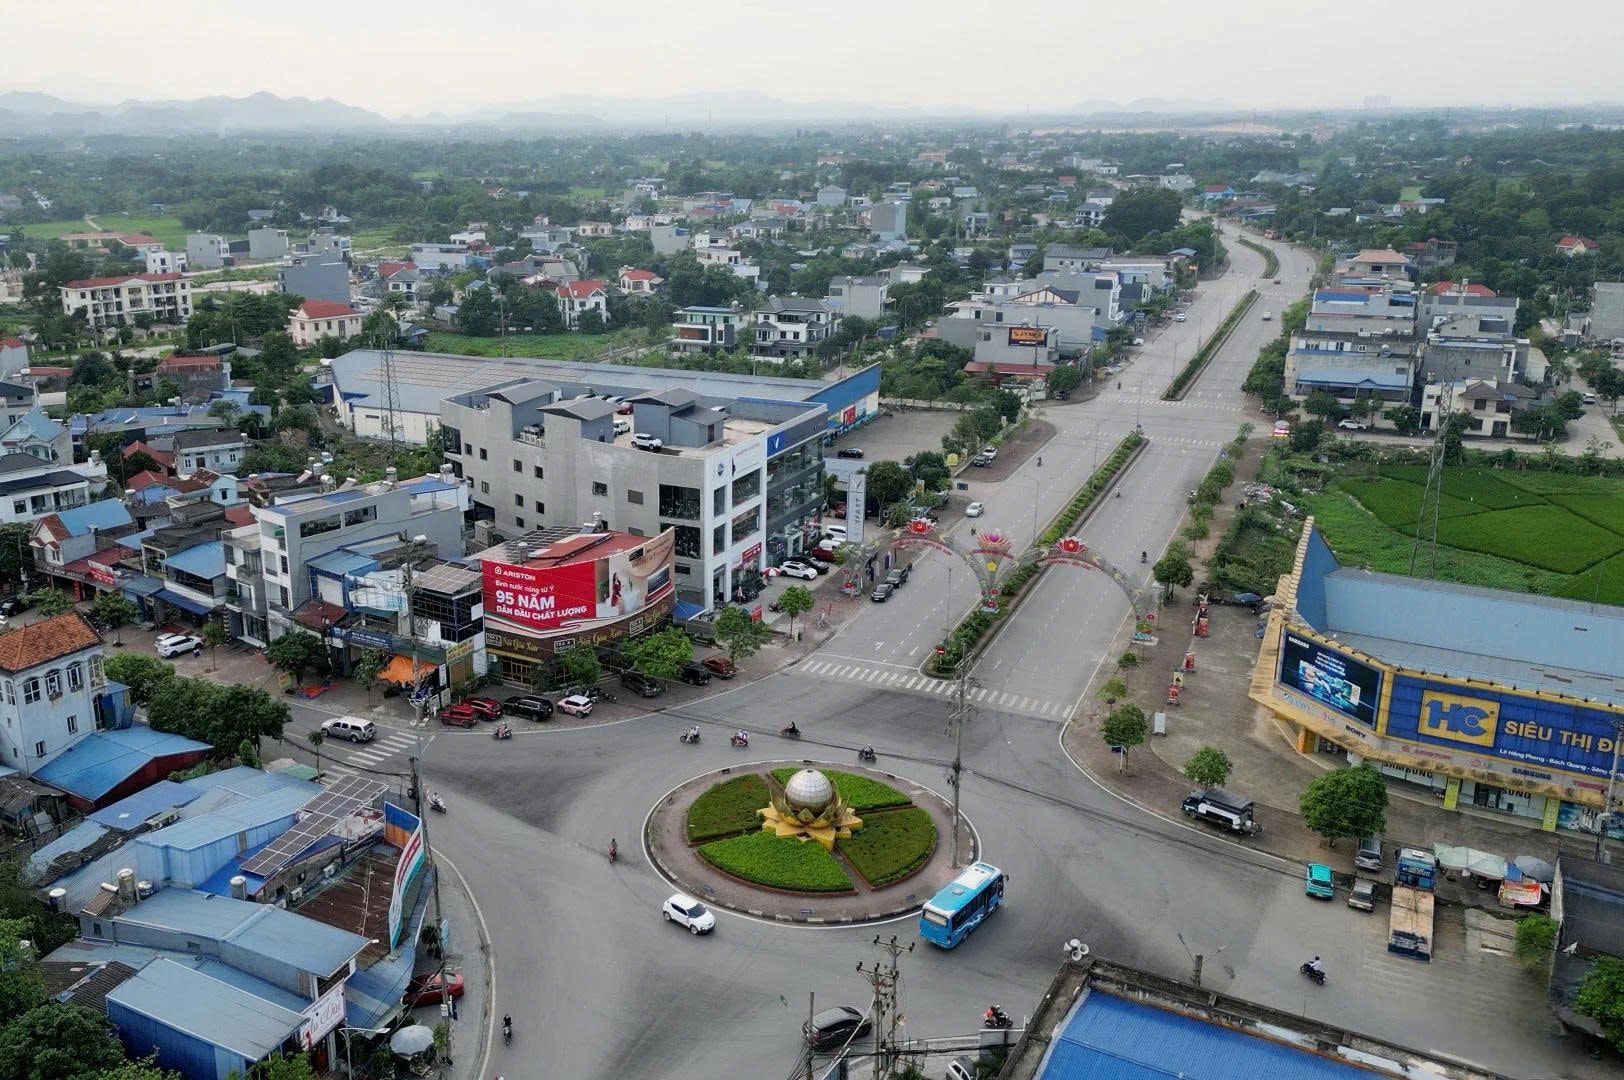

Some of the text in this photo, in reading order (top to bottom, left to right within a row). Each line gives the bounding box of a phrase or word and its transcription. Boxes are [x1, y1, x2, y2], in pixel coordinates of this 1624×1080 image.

[502, 569, 536, 581] ARISTON
[495, 579, 509, 587] Bình
[509, 582, 523, 591] nước
[524, 585, 540, 594] nóng
[495, 589, 555, 611] 95 NĂM
[513, 606, 531, 618] ĐẦU
[532, 608, 556, 620] CHẤT
[557, 605, 588, 618] LƯỢNG
[1426, 699, 1490, 737] HC
[1345, 724, 1367, 739] SONY
[1504, 720, 1552, 741] SIÊU
[1559, 730, 1593, 753] THỊ
[1525, 752, 1545, 763] Phong
[1548, 757, 1566, 766] Bách
[1566, 761, 1587, 772] Quang
[1512, 767, 1552, 780] SAMSUNG
